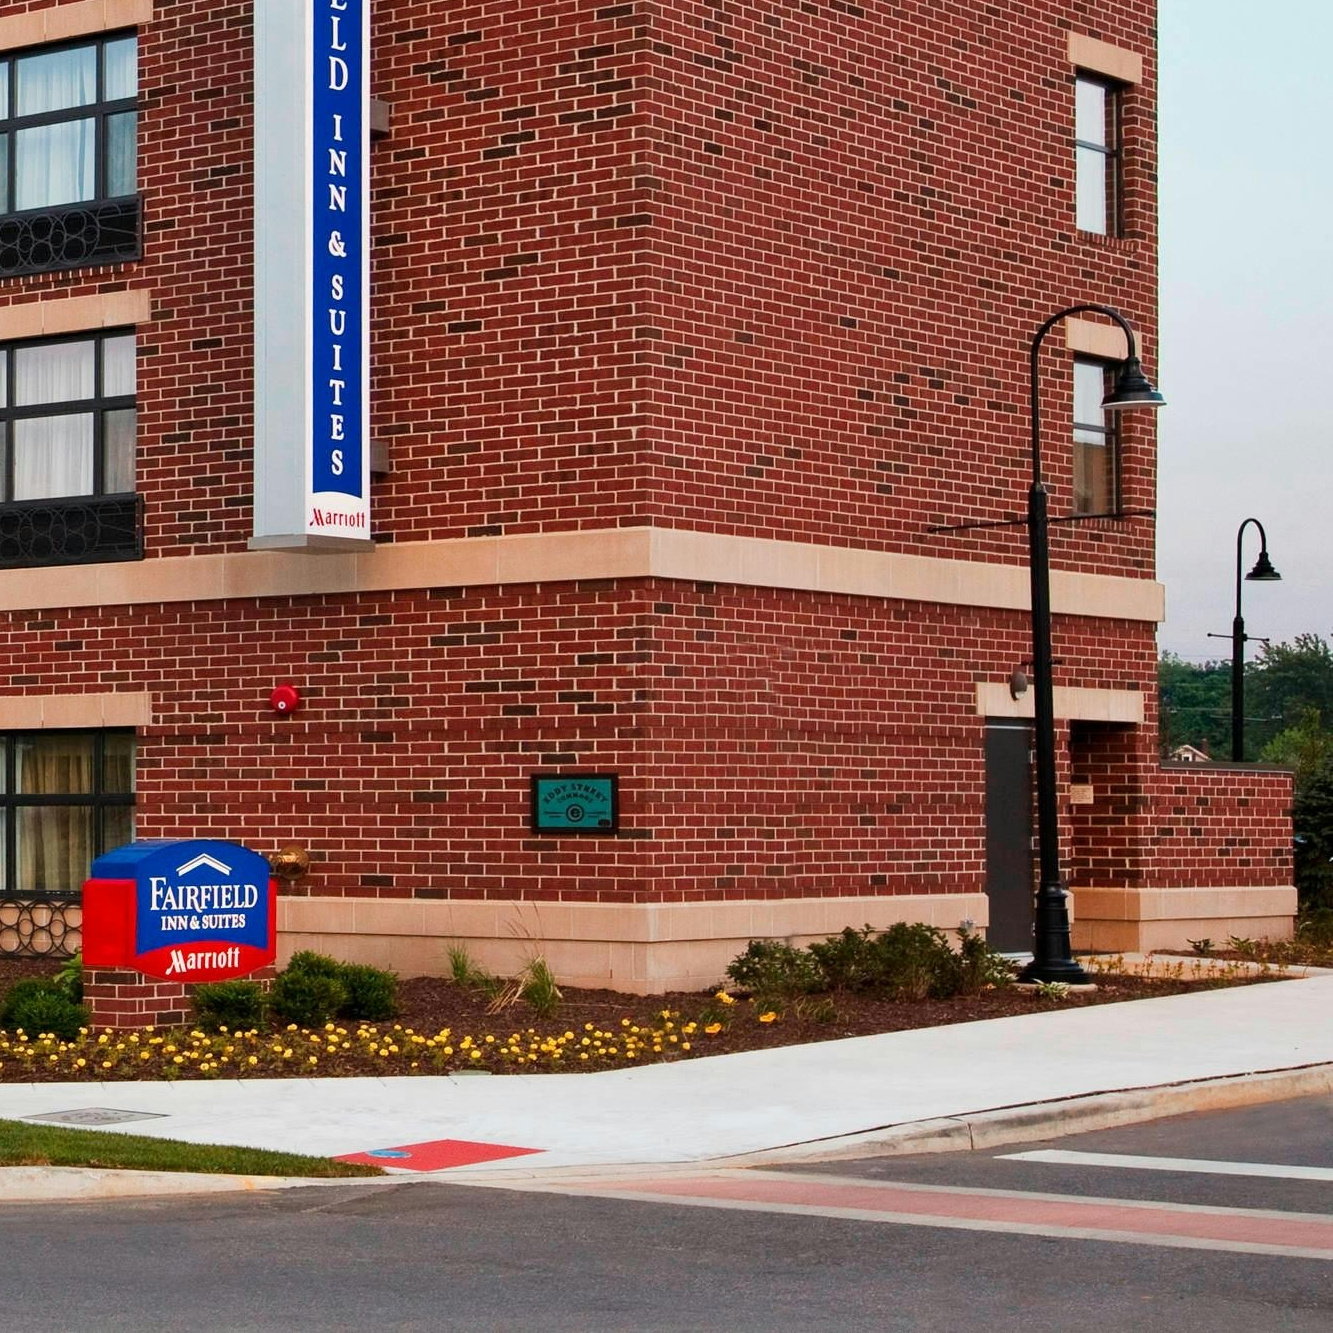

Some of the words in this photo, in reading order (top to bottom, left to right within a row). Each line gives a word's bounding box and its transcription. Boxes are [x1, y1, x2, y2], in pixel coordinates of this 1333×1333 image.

[328, 114, 347, 213] INN
[328, 230, 347, 258] &
[329, 274, 347, 476] SUITES
[310, 508, 365, 528] Marriott
[571, 783, 607, 802] STREET
[149, 877, 259, 913] FAIRFIELD
[161, 916, 188, 930] INN
[190, 917, 200, 930] &
[202, 914, 246, 929] SUITES
[165, 947, 240, 975] Marriott
